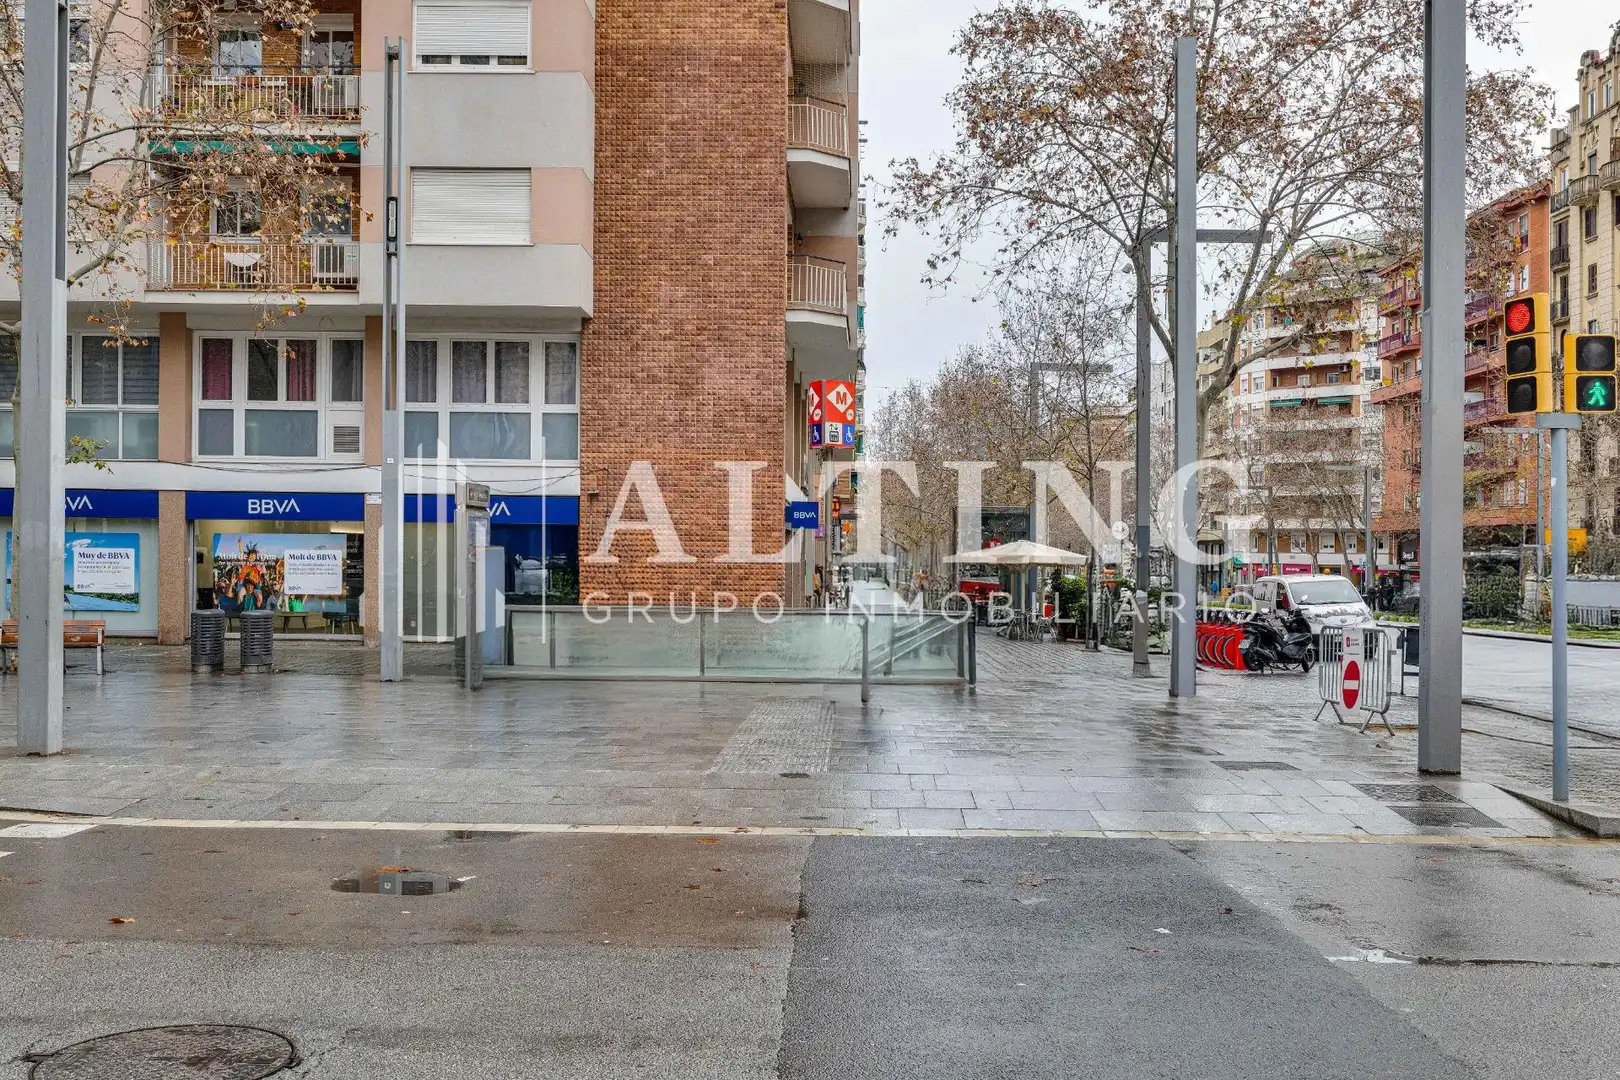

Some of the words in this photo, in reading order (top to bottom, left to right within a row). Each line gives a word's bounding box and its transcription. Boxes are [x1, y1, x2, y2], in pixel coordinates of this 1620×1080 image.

[835, 391, 847, 405] M
[65, 495, 93, 511] VA
[248, 498, 300, 514] BBVA
[486, 501, 511, 517] VA
[793, 511, 816, 519] BBVA
[78, 552, 96, 560] Muy
[96, 551, 107, 559] de
